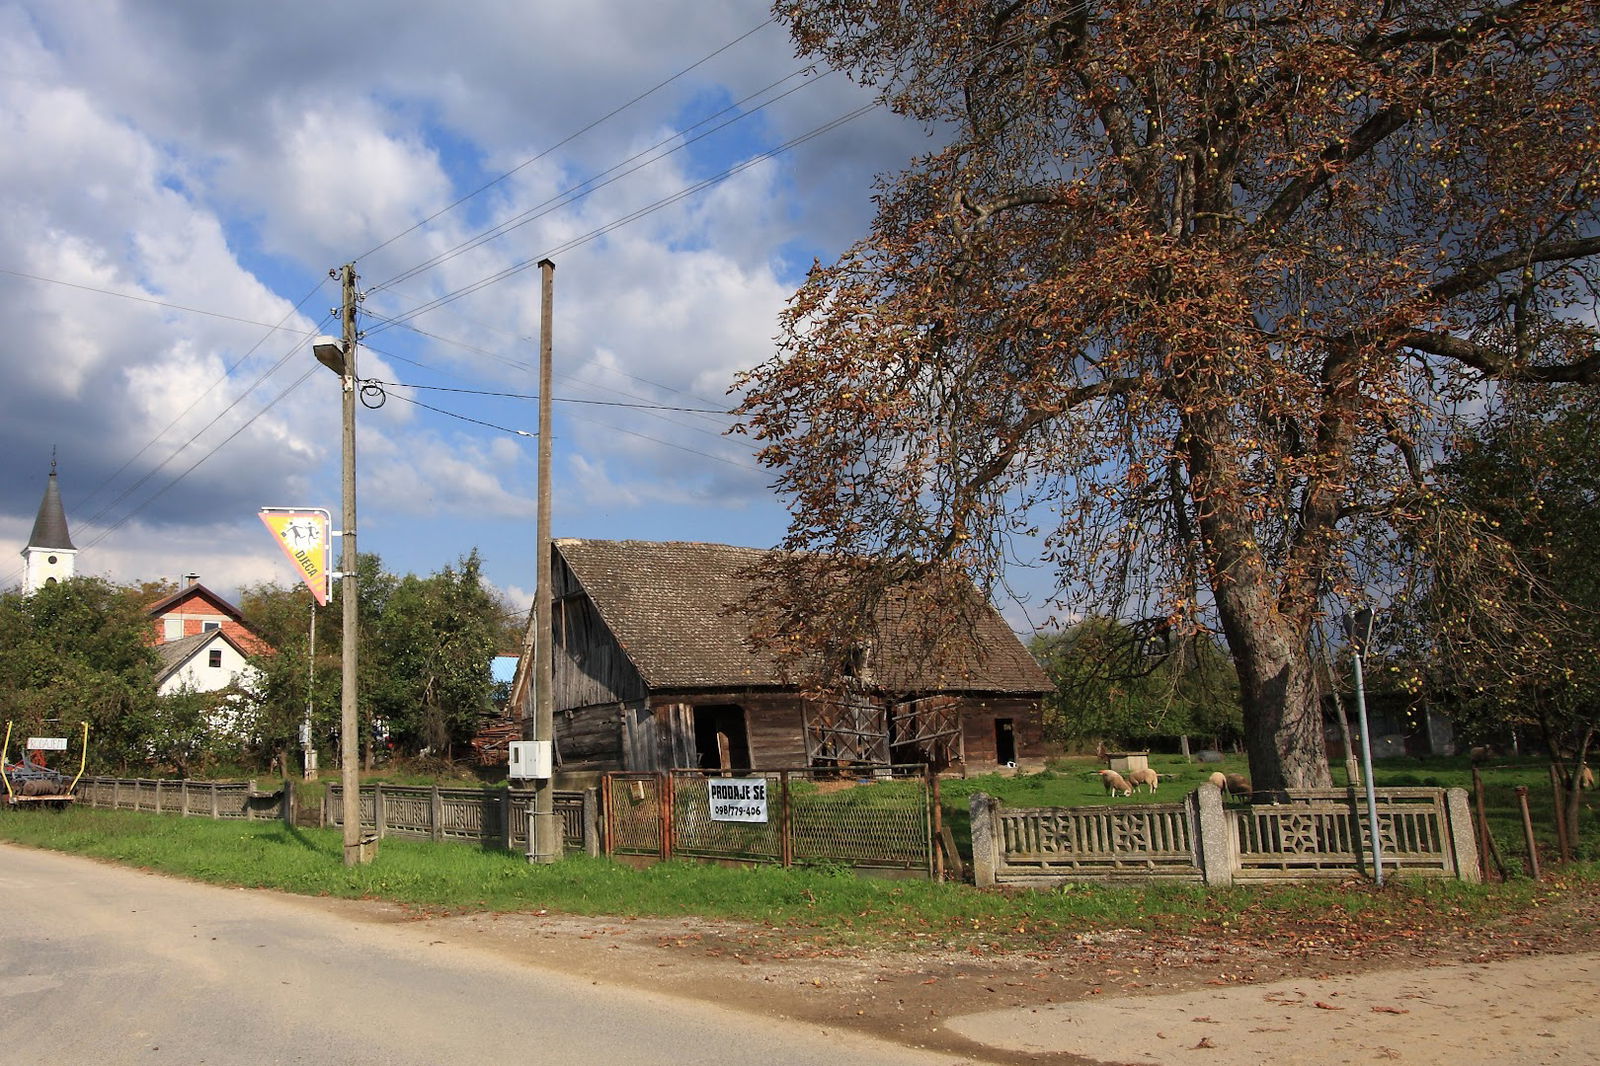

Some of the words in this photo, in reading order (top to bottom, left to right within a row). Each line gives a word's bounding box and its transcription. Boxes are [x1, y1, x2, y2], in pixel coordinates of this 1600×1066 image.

[295, 550, 318, 577] DJECA
[711, 785, 750, 800] PRODAJE
[753, 785, 765, 800] SE
